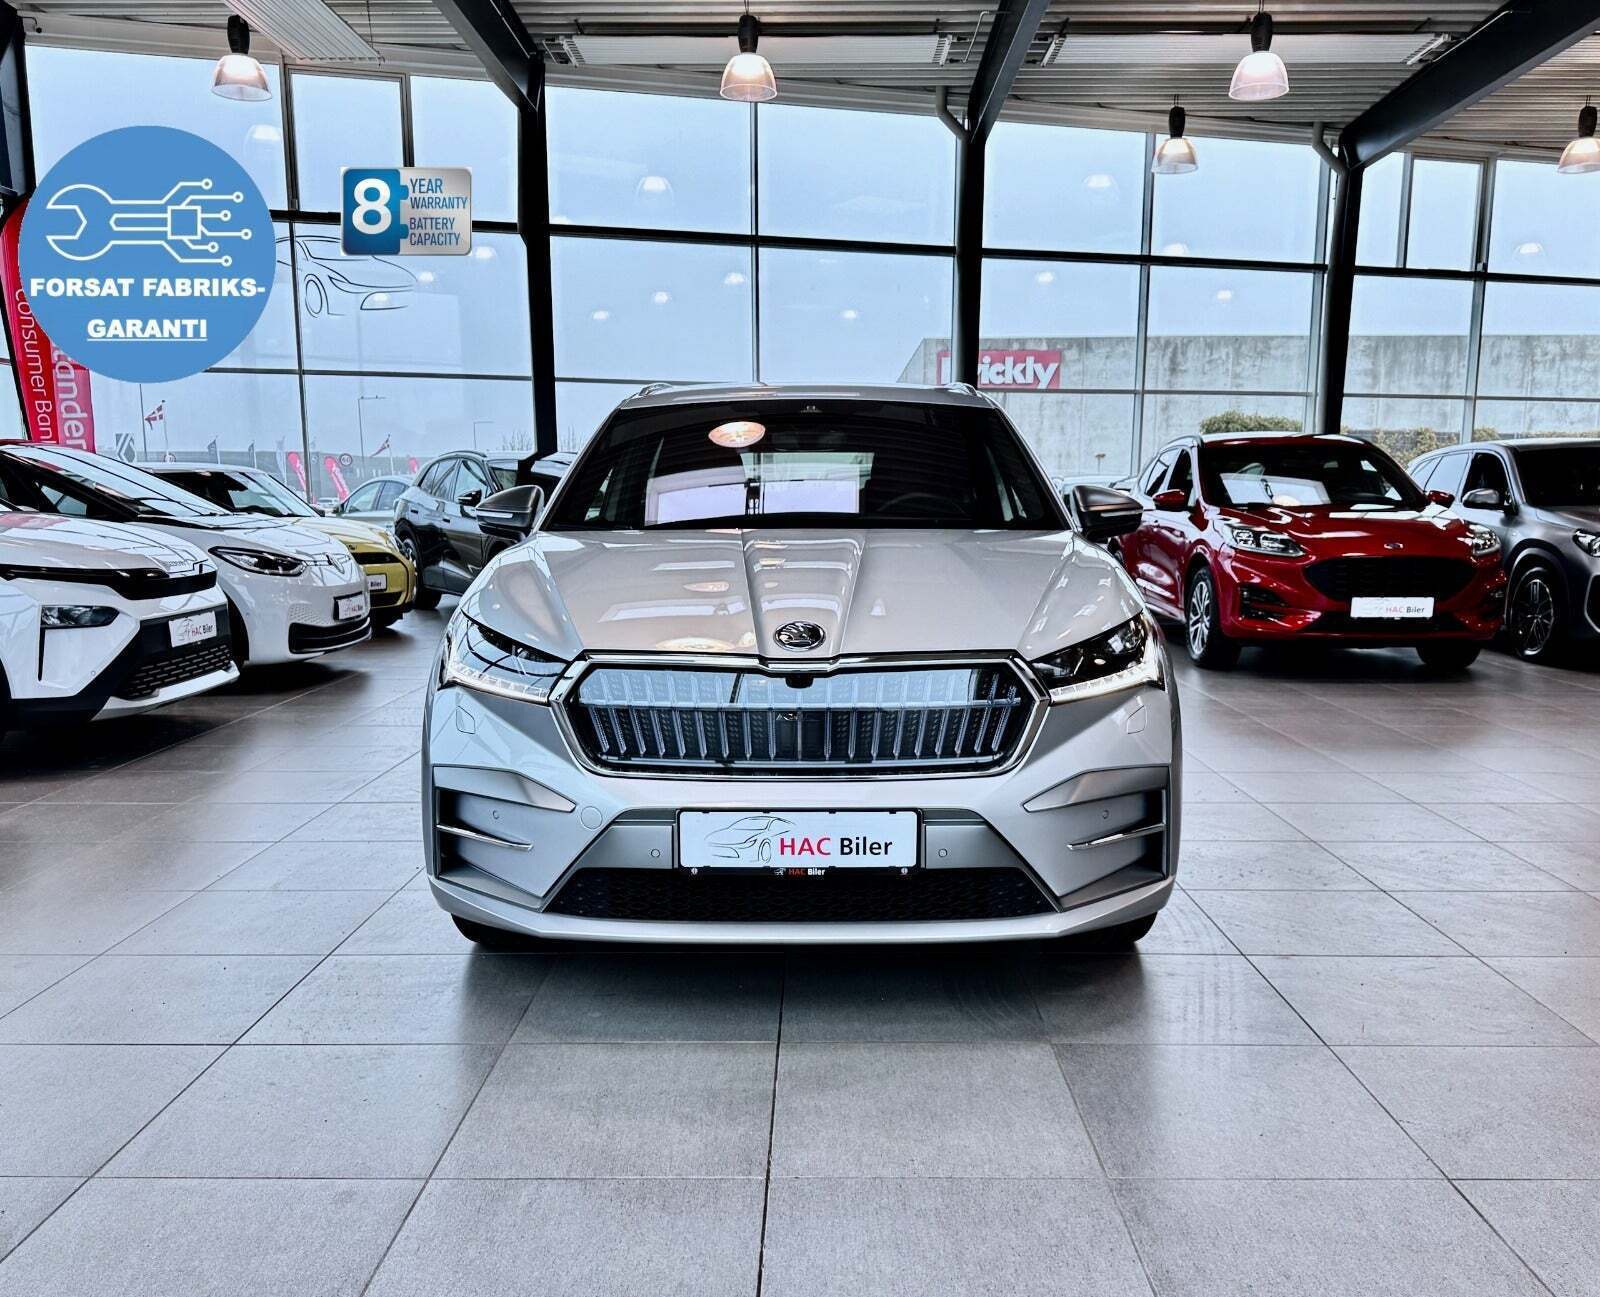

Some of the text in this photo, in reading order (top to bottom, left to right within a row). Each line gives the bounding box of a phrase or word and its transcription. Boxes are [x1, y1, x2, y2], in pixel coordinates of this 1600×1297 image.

[35, 400, 57, 444] Ban
[779, 836, 893, 856] HAC Biler
[788, 867, 826, 876] HAC Biler
